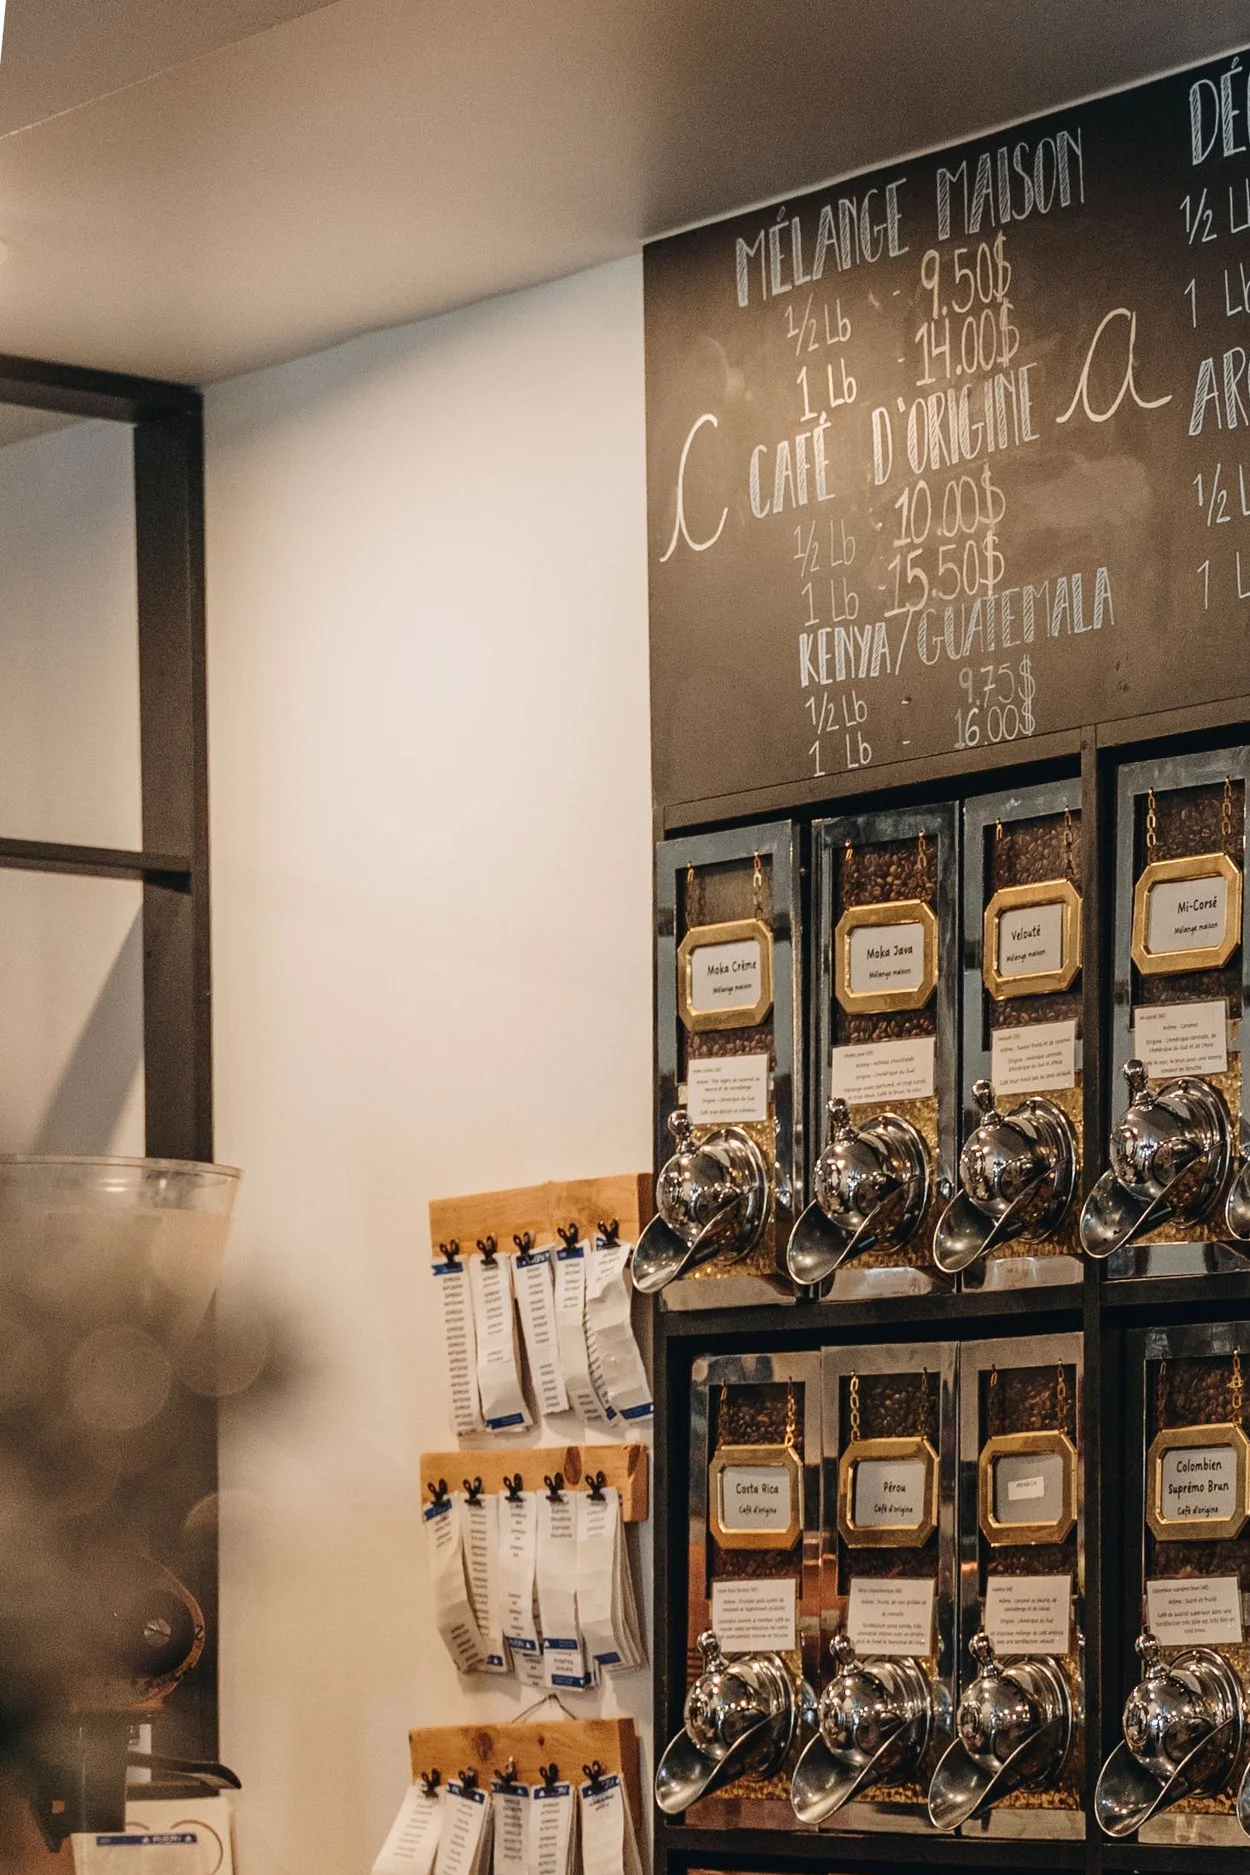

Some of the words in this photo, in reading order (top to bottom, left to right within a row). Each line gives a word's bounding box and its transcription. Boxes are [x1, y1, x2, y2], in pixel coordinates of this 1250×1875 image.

[736, 178, 909, 307] MÉLANGE
[937, 128, 1085, 241] MAISON
[824, 308, 852, 347] Lb
[920, 231, 1013, 320] 9.50$
[1183, 278, 1197, 328] 1
[798, 367, 817, 421] 1
[827, 365, 858, 407] Lb
[915, 299, 1020, 386] 14.00$
[749, 412, 836, 520] CAFÉ
[872, 362, 1040, 487] D'ORIGINE
[828, 530, 857, 567] Lb
[894, 461, 1007, 547] 10.00$
[802, 583, 818, 626] 1
[828, 587, 860, 623] Lb
[885, 530, 1005, 618] 15.50$
[1197, 561, 1212, 609] 1
[839, 697, 868, 728] Lb
[959, 653, 1037, 707] 9.75$
[809, 740, 827, 778] 1
[845, 737, 873, 769] Lb
[953, 697, 1037, 750] 16.00$
[1177, 895, 1217, 914] Mi-Corsé
[1011, 925, 1041, 941] Velouté
[1174, 925, 1198, 936] Mélange
[1199, 921, 1219, 931] maison
[867, 945, 890, 960] Moka
[893, 945, 914, 956] Java
[707, 962, 729, 976] Moka
[731, 959, 757, 972] Crème
[1176, 1457, 1222, 1473] Colombien
[736, 1482, 759, 1495] Costa
[762, 1482, 779, 1494] Rica
[883, 1480, 905, 1493] Pérou
[1168, 1482, 1204, 1500] Suprémo
[1208, 1480, 1229, 1493] Brun
[739, 1505, 751, 1515] Café
[753, 1505, 777, 1517] d'origine
[874, 1503, 888, 1514] Café
[889, 1504, 913, 1516] d'origine
[1177, 1505, 1191, 1517] Café
[1192, 1505, 1218, 1518] d'origine
